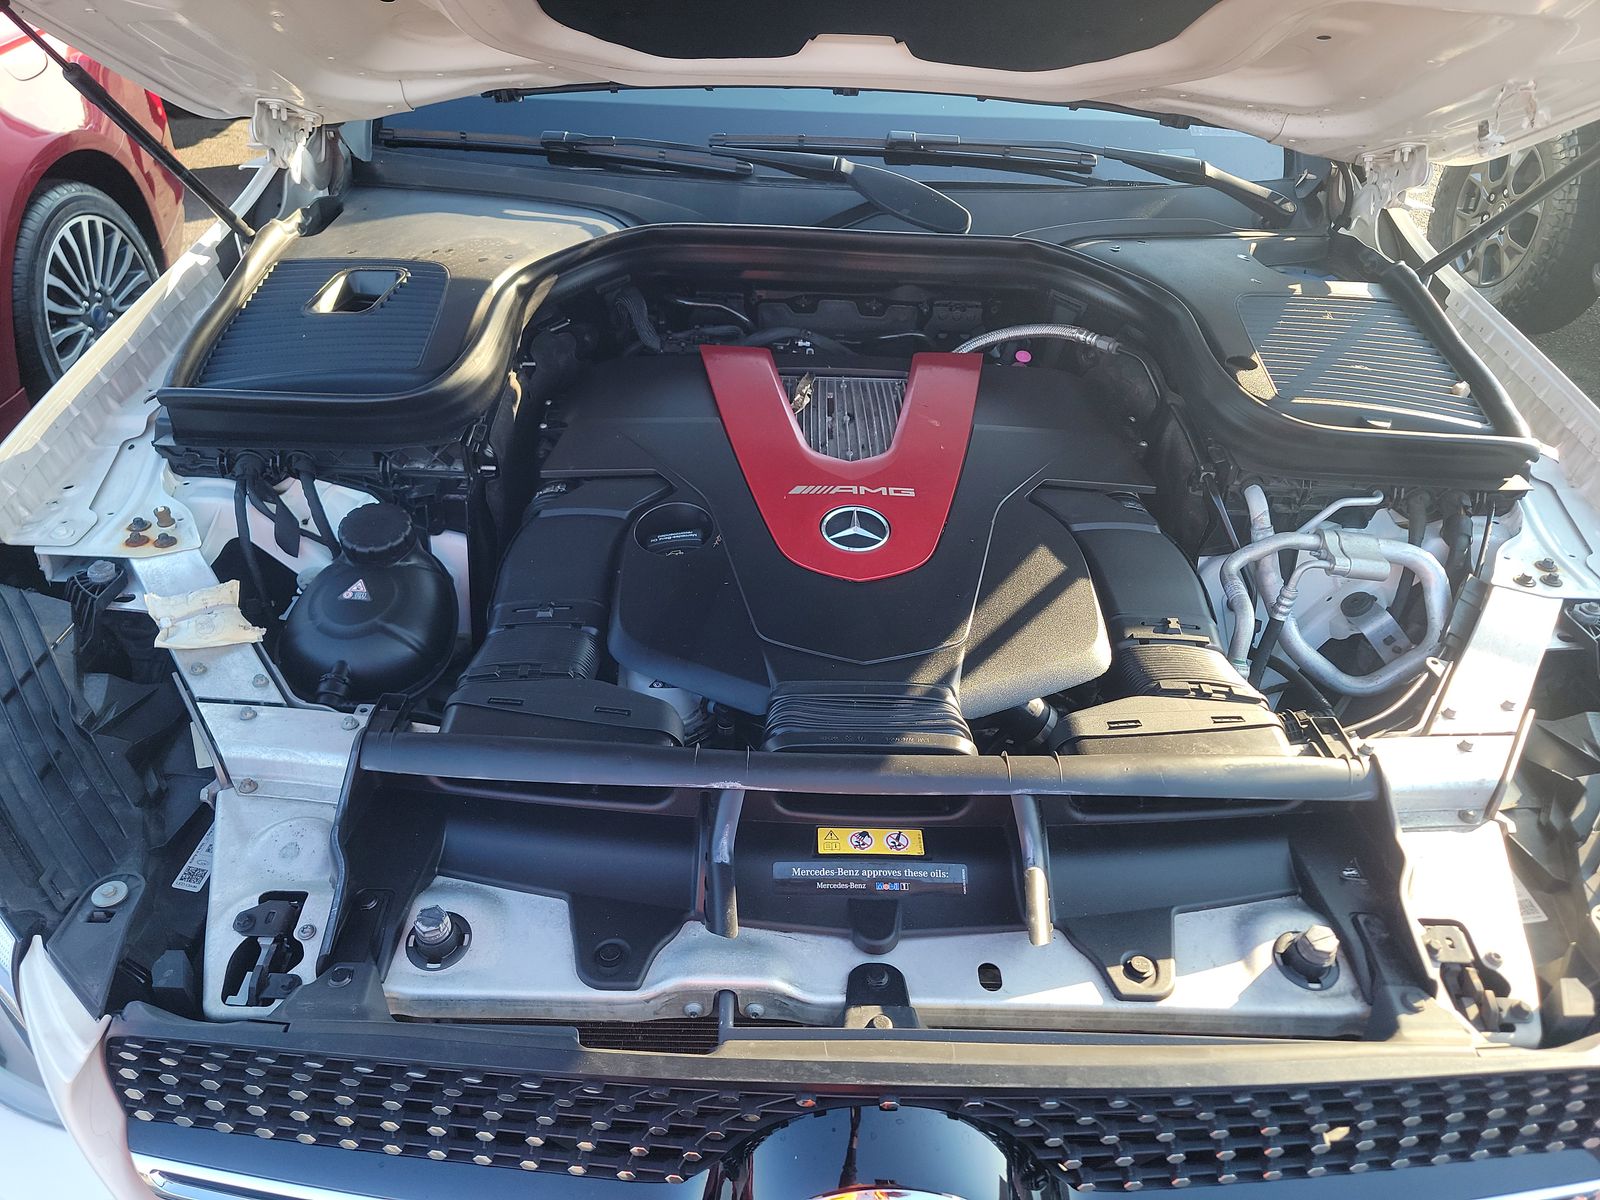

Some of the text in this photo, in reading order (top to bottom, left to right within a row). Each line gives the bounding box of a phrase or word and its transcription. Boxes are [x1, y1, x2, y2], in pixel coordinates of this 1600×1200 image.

[829, 485, 916, 497] AMG
[792, 867, 949, 878] Mercedes-Benz approves these oils:
[875, 882, 900, 891] Mobil
